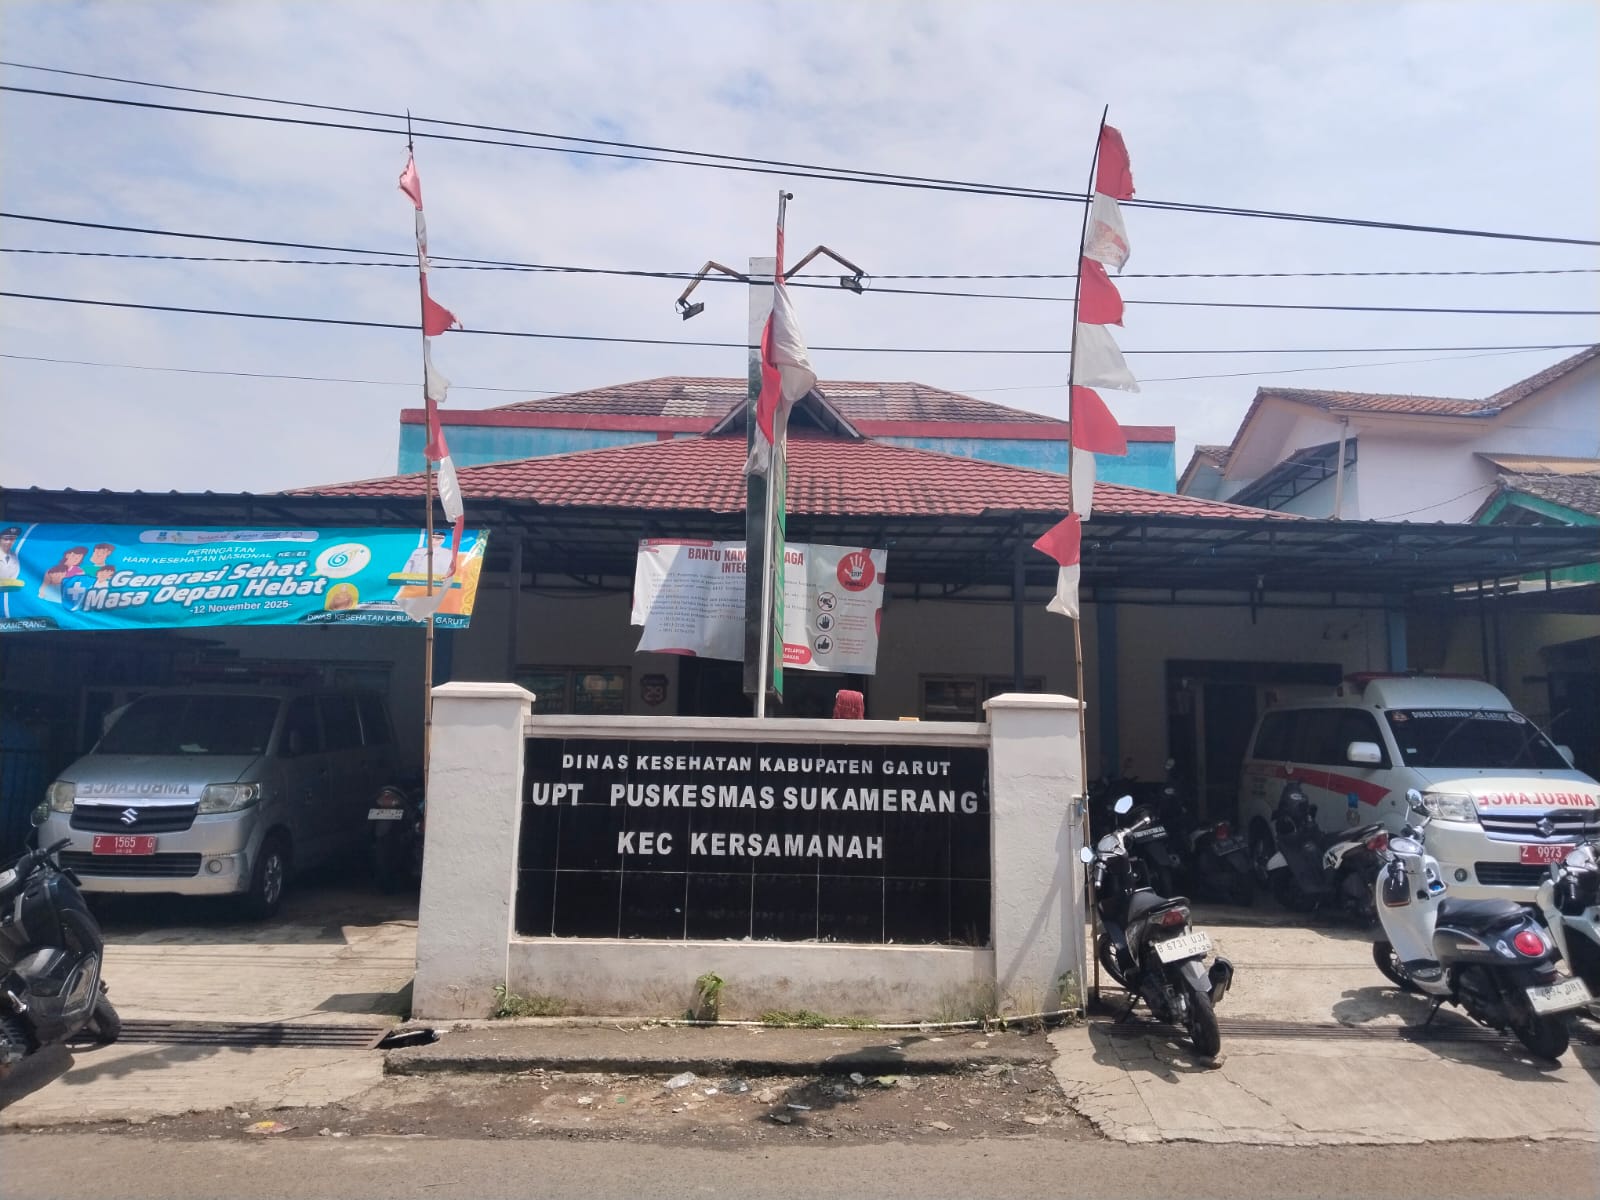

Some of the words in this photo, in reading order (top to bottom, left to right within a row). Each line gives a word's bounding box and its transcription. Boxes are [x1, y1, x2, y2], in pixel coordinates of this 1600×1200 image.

[187, 546, 255, 556] PERINGATAN
[687, 548, 721, 561] BANTU
[724, 548, 747, 561] KAM
[122, 556, 150, 564] HARI
[151, 554, 216, 564] KESEHATAN
[218, 552, 272, 562] NASIONAL
[111, 563, 227, 588] Generasi
[228, 561, 307, 581] Sehat
[83, 588, 148, 612] Masa
[153, 582, 240, 606] Depan
[243, 576, 326, 598] Hebat
[208, 601, 261, 613] November
[334, 613, 384, 622] KESEHATAN
[435, 616, 464, 625] GARUT
[562, 754, 629, 770] DINAS
[636, 755, 751, 772] KESEHATAN
[759, 757, 873, 775] KABUPATEN
[882, 760, 951, 776] GARUT
[532, 782, 584, 806] UPT
[610, 783, 774, 809] PUSKESMAS
[783, 787, 978, 814] SUKAMERANG
[95, 837, 102, 848] Z
[114, 837, 136, 848] 1565
[617, 831, 673, 855] KEC
[690, 832, 884, 859] KERSAMANAH
[1521, 847, 1529, 857] Z
[1537, 846, 1562, 858] 9973
[1157, 943, 1164, 953] B
[1166, 937, 1187, 951] 6731
